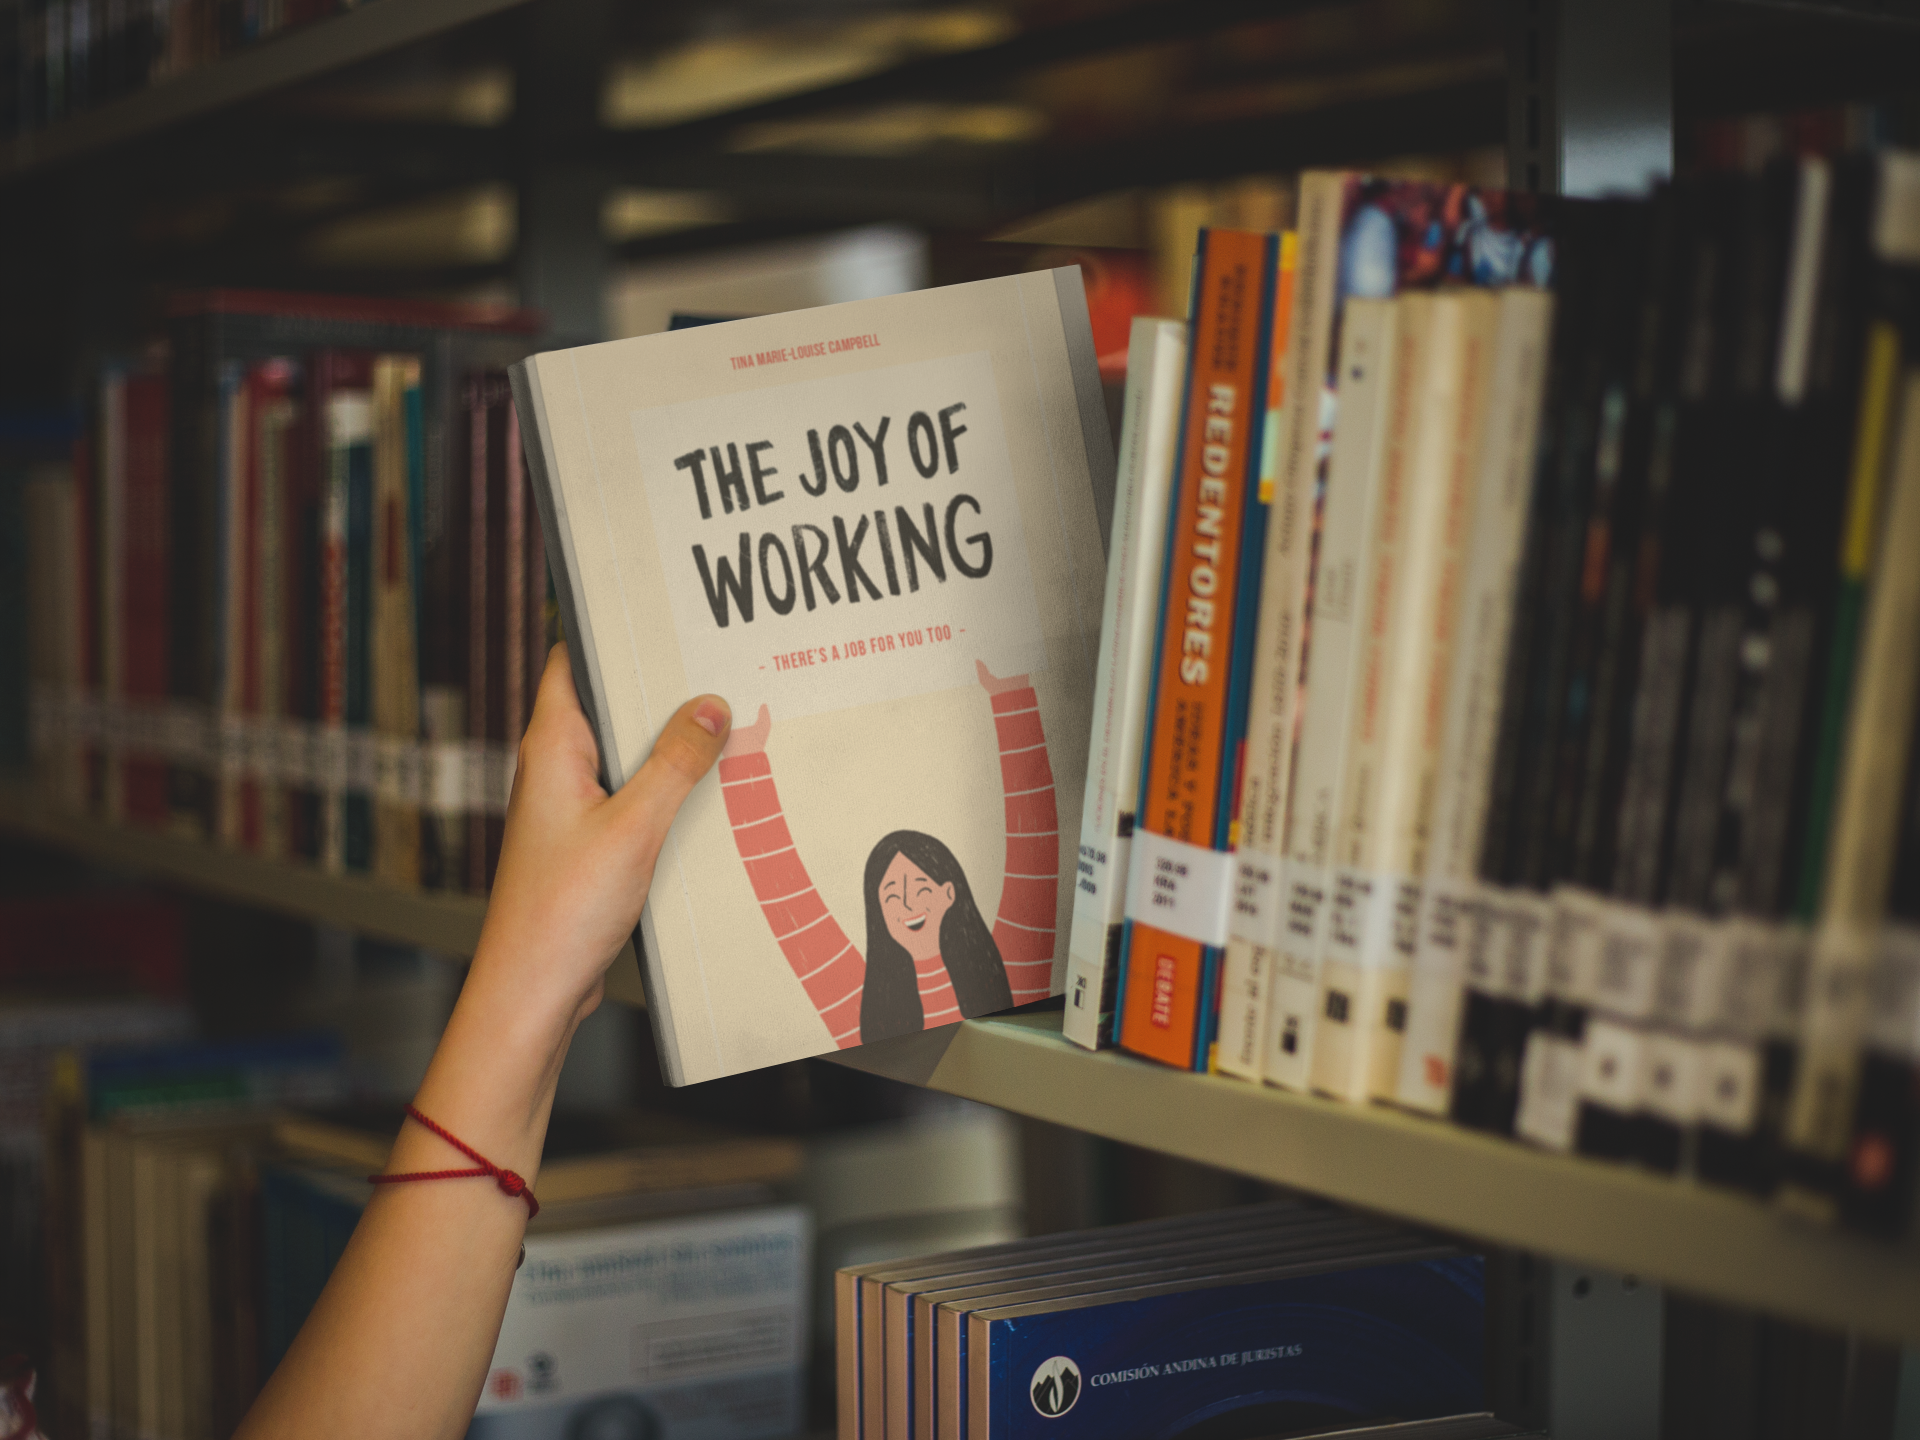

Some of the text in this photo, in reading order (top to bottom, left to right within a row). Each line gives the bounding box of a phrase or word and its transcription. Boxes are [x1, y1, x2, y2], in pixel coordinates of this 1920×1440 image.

[730, 333, 881, 370] TINA MARIE-LOUISE CAMPBELL
[674, 402, 968, 520] THE JOY OF
[692, 493, 993, 628] WORKING
[1180, 382, 1237, 687] REDENTORES
[772, 646, 828, 672] THERE'S
[832, 645, 840, 661] A
[844, 640, 867, 659] JOB
[870, 634, 895, 654] FOR
[897, 629, 923, 648] YOU
[926, 624, 951, 643] TOO
[1152, 957, 1175, 1027] DEBATE
[1090, 1344, 1303, 1387] COMISIÓN ANDINA DE JURISTAS
